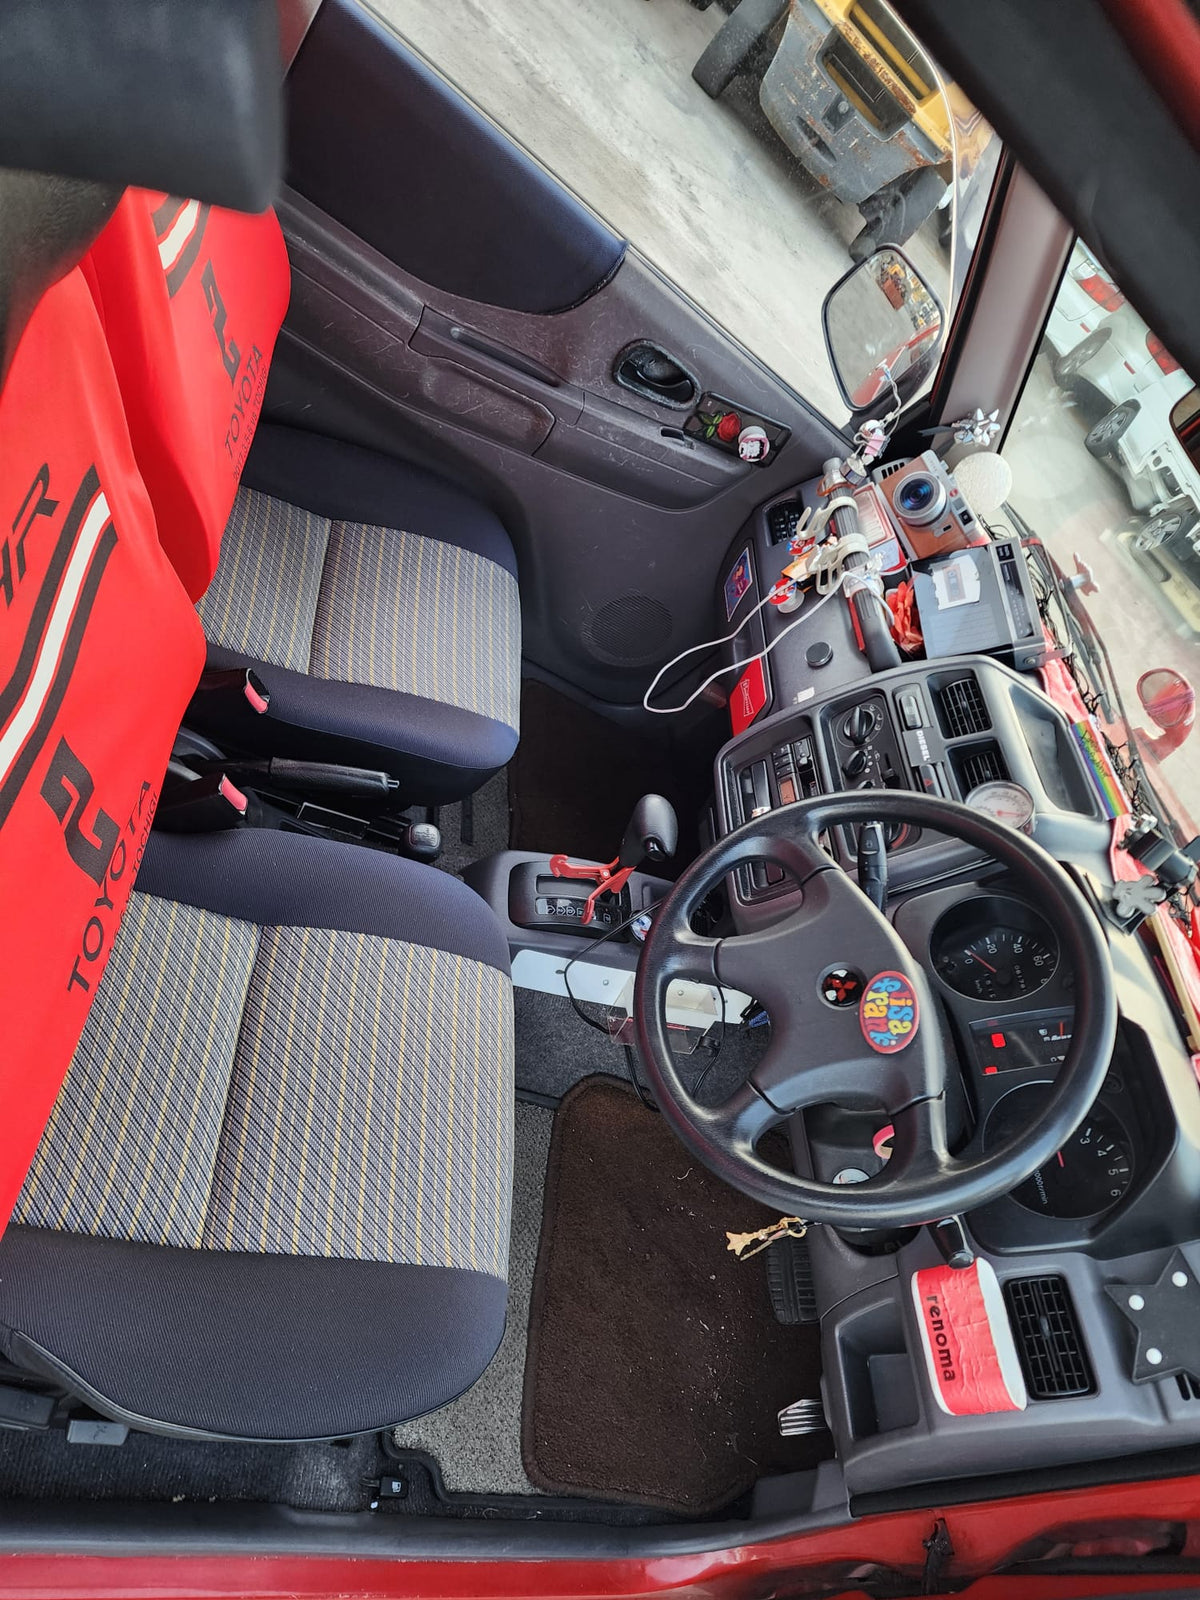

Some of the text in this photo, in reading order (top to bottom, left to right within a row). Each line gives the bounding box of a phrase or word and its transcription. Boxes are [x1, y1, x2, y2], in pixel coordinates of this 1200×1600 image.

[225, 345, 262, 459] TOYOTA
[916, 730, 931, 761] DIESEL
[67, 781, 151, 992] TOYOTA
[986, 943, 998, 954] 20
[1013, 943, 1024, 954] 40
[1033, 955, 1044, 966] 60
[863, 977, 902, 1047] frank
[887, 991, 914, 1035] lisa
[1080, 1137, 1090, 1145] 3
[1108, 1168, 1119, 1176] 5
[926, 1295, 956, 1382] renoma
